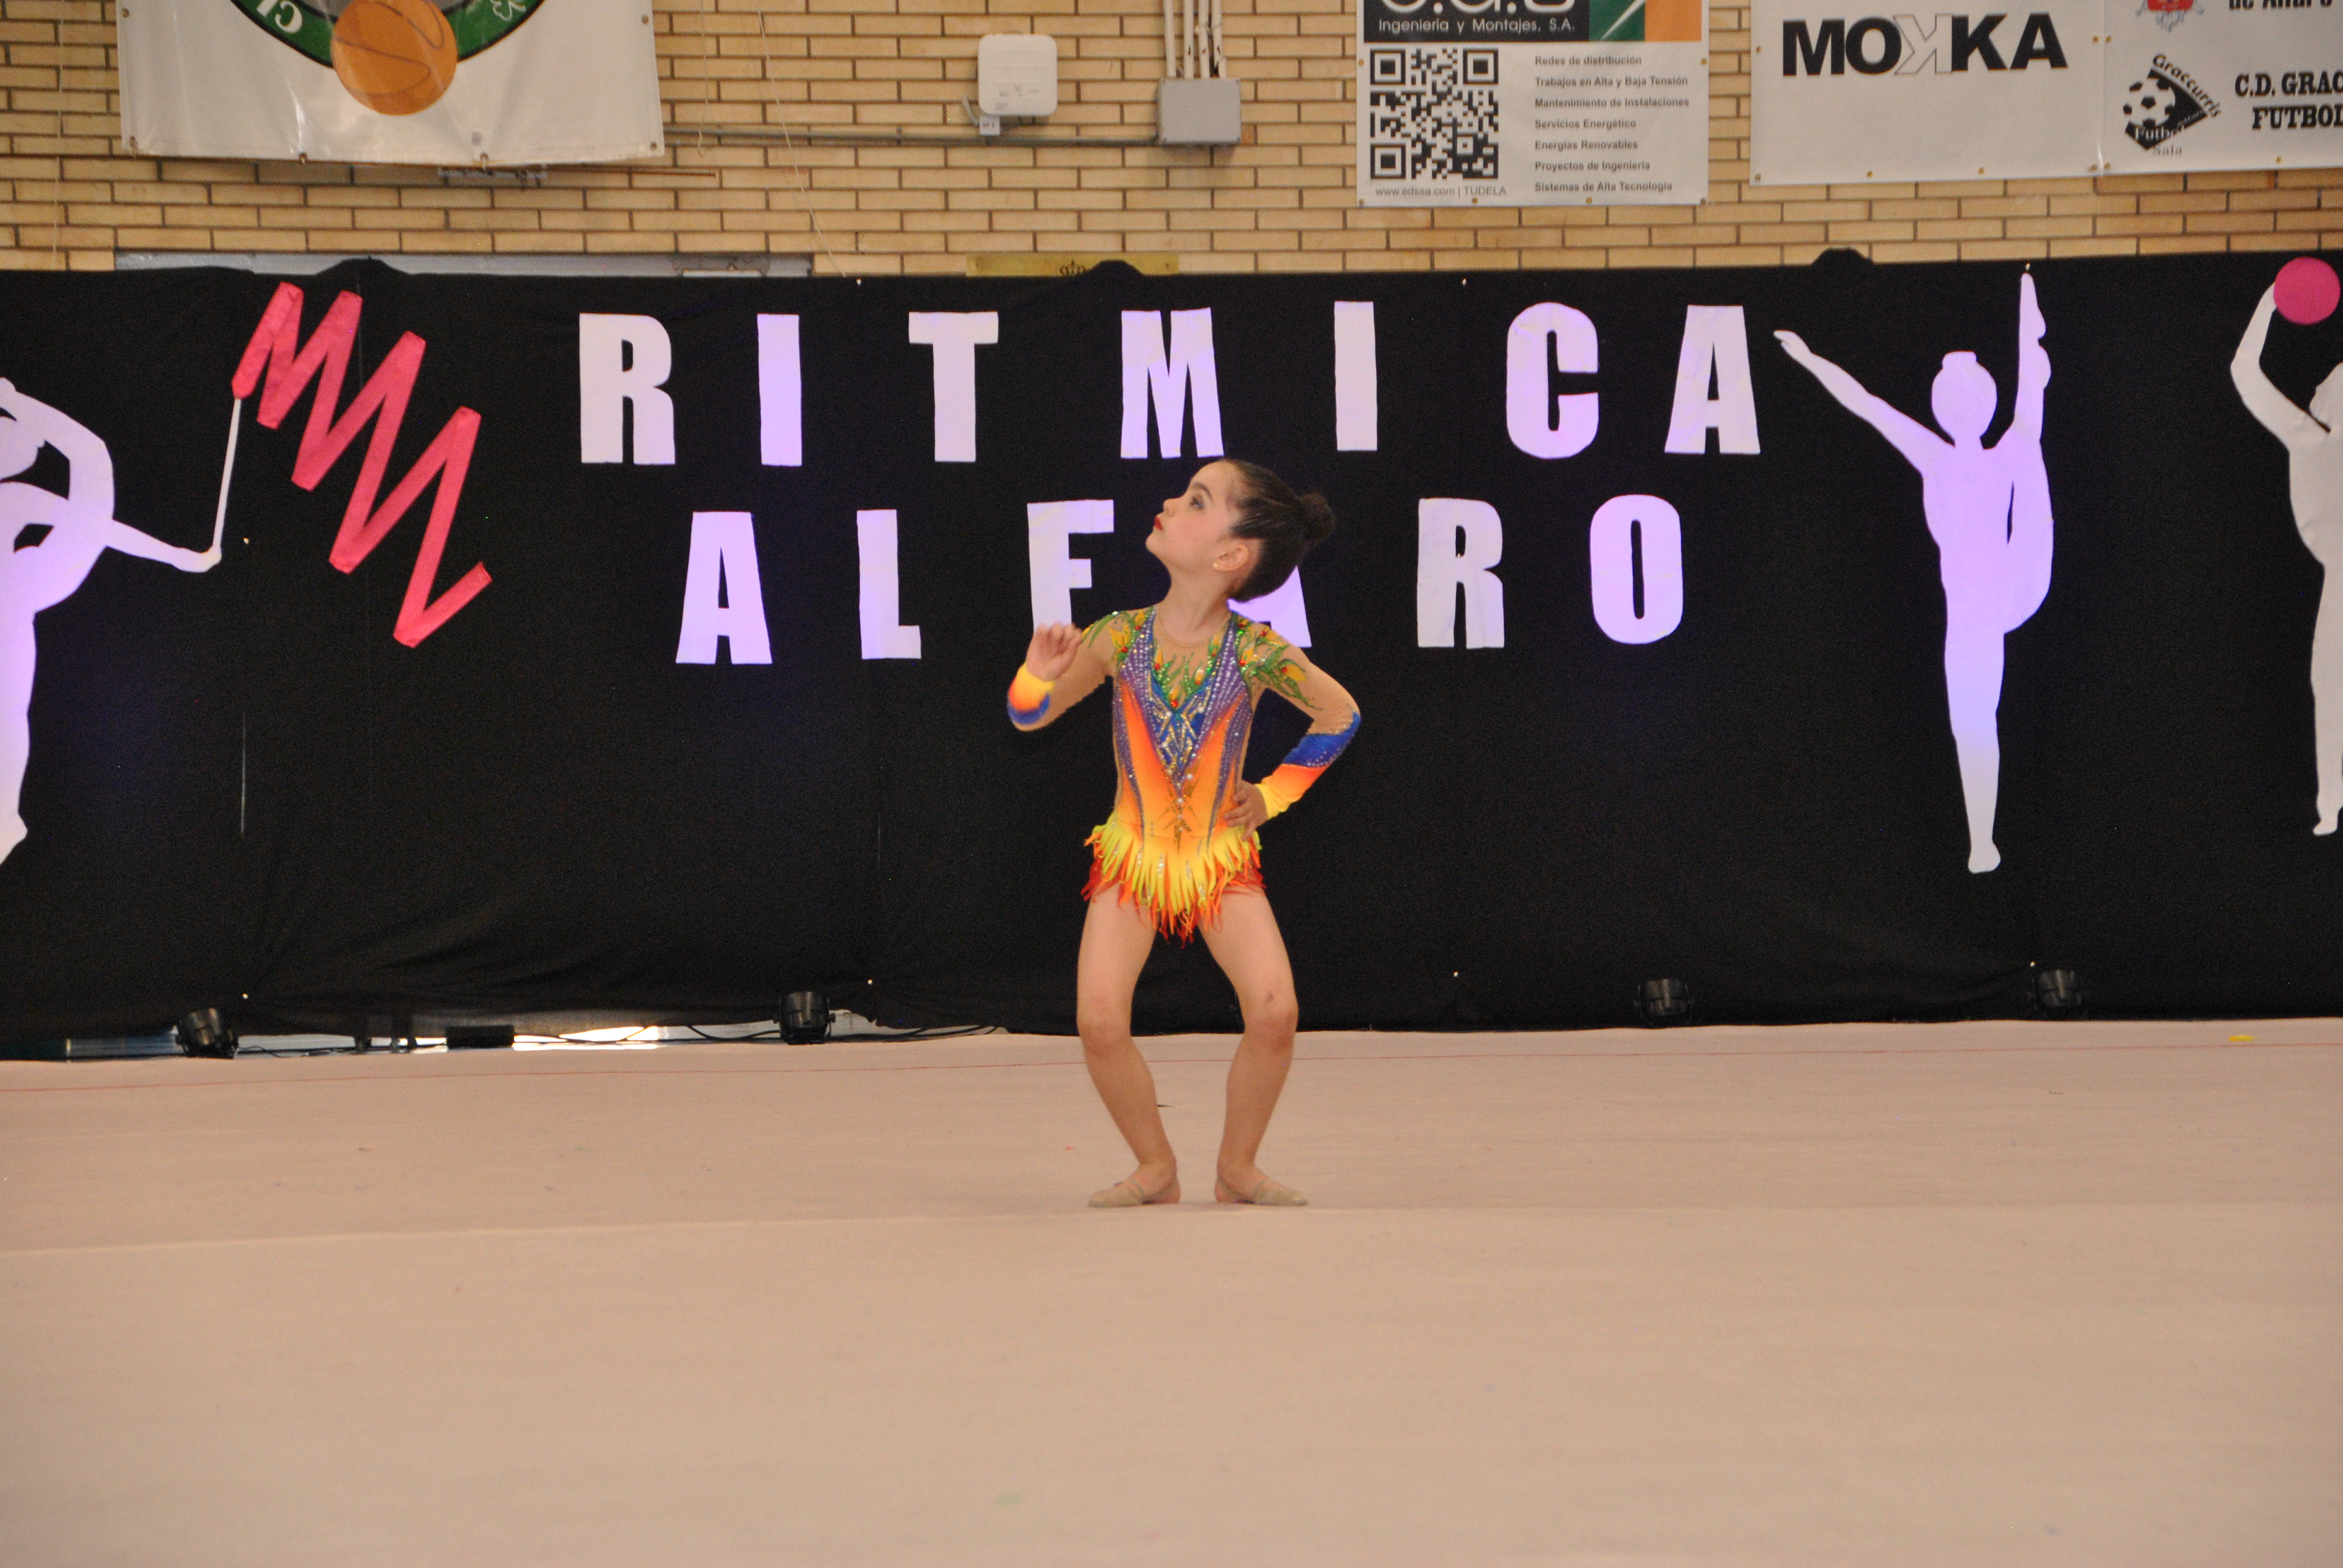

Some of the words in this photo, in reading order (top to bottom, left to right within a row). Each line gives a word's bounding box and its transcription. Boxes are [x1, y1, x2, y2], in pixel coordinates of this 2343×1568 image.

[1457, 20, 1466, 34] y
[1472, 17, 1541, 35] Montajes,
[1549, 17, 1575, 31] S.A.
[1535, 55, 1566, 65] Redes
[1568, 55, 1581, 65] de
[1583, 54, 1642, 65] distribución
[1535, 76, 1577, 88] Trabajos
[1579, 77, 1592, 86] en
[1594, 76, 1613, 87] Alta
[1616, 77, 1622, 88] y
[1625, 76, 1647, 88] Baja
[1649, 74, 1688, 86] Tensión
[2152, 53, 2221, 117] Graccurris
[2234, 73, 2276, 97] C.D.
[1535, 97, 1607, 108] Mantenimiento
[1610, 97, 1622, 107] de
[1625, 96, 1690, 107] Instalaciones
[1535, 119, 1581, 129] Servicios
[1583, 118, 1637, 130] Energético
[1581, 139, 1639, 150] Renovables
[1535, 160, 1584, 172] Proyectos
[1587, 160, 1599, 170] de
[1375, 186, 1455, 196] www.edssa.com
[1463, 186, 1507, 195] TUDELA
[1535, 181, 1580, 192] Sistemas
[1582, 181, 1595, 191] de
[1597, 181, 1616, 191] Alta
[579, 301, 1761, 467] RITMICA
